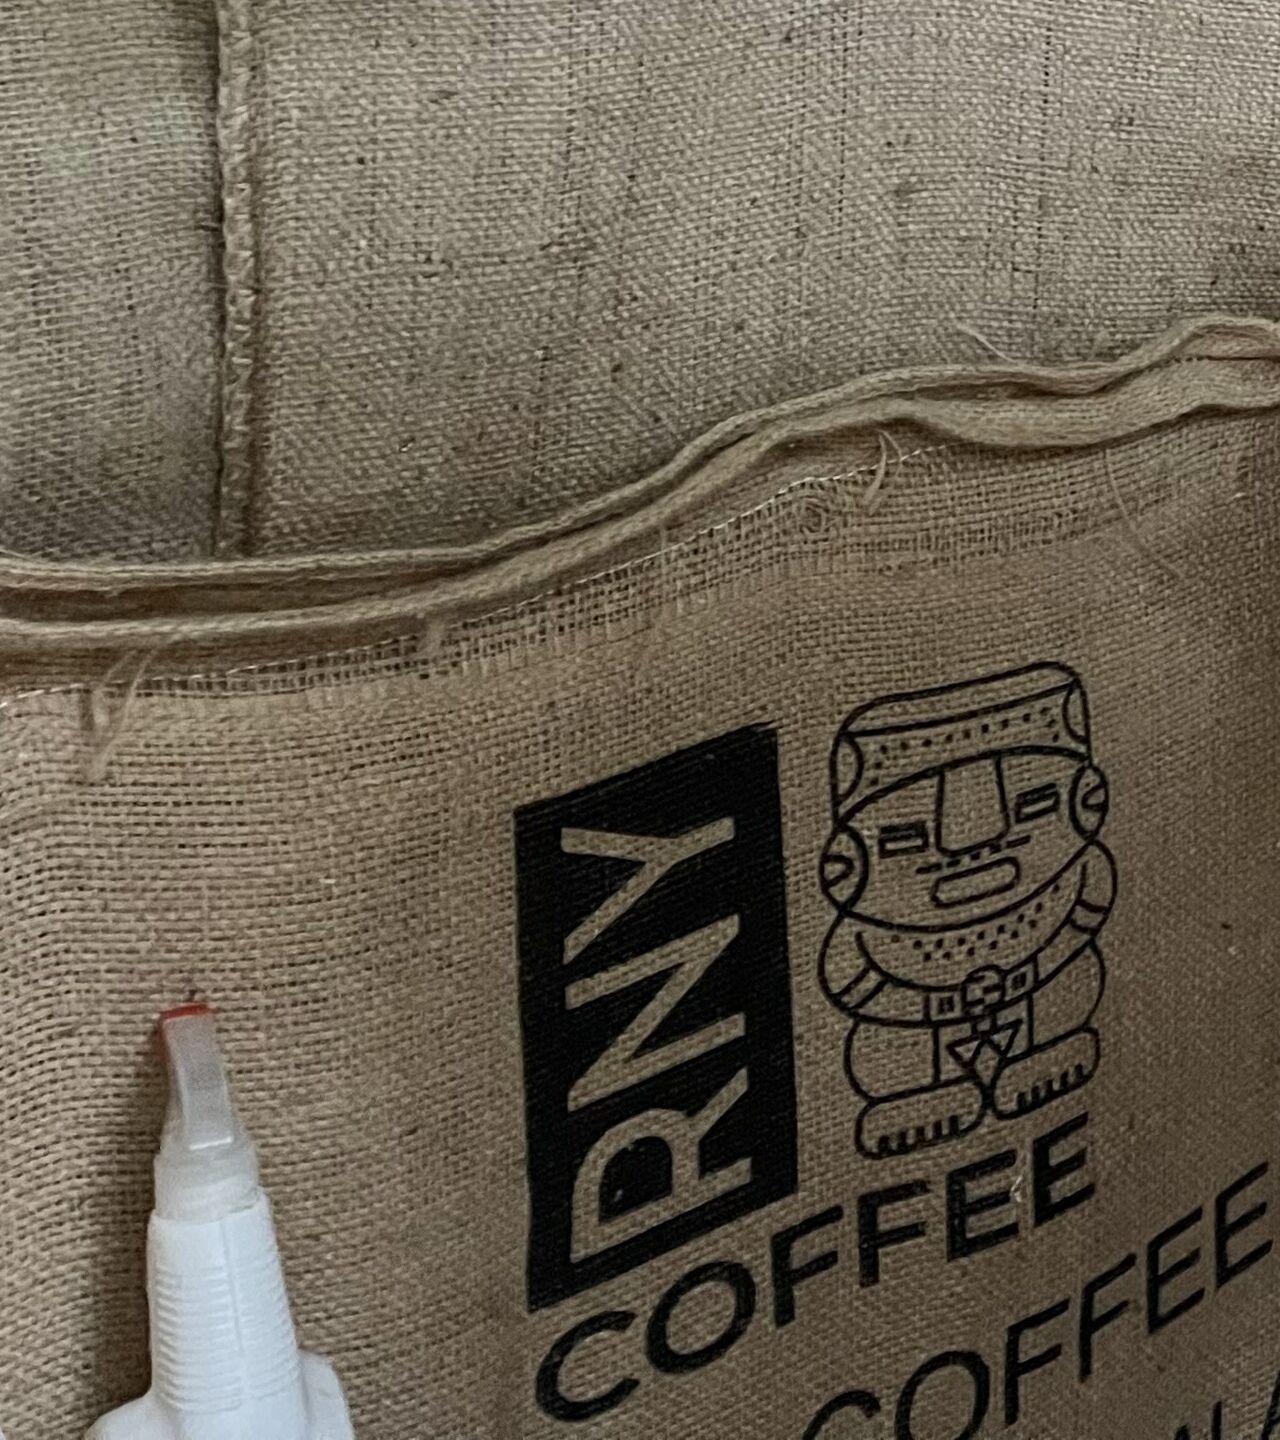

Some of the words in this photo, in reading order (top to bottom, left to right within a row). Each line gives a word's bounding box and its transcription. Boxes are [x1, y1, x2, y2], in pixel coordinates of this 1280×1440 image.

[560, 816, 755, 1266] RNY
[534, 1111, 1098, 1424] COFFEE
[799, 1162, 1274, 1440] COFFEE
